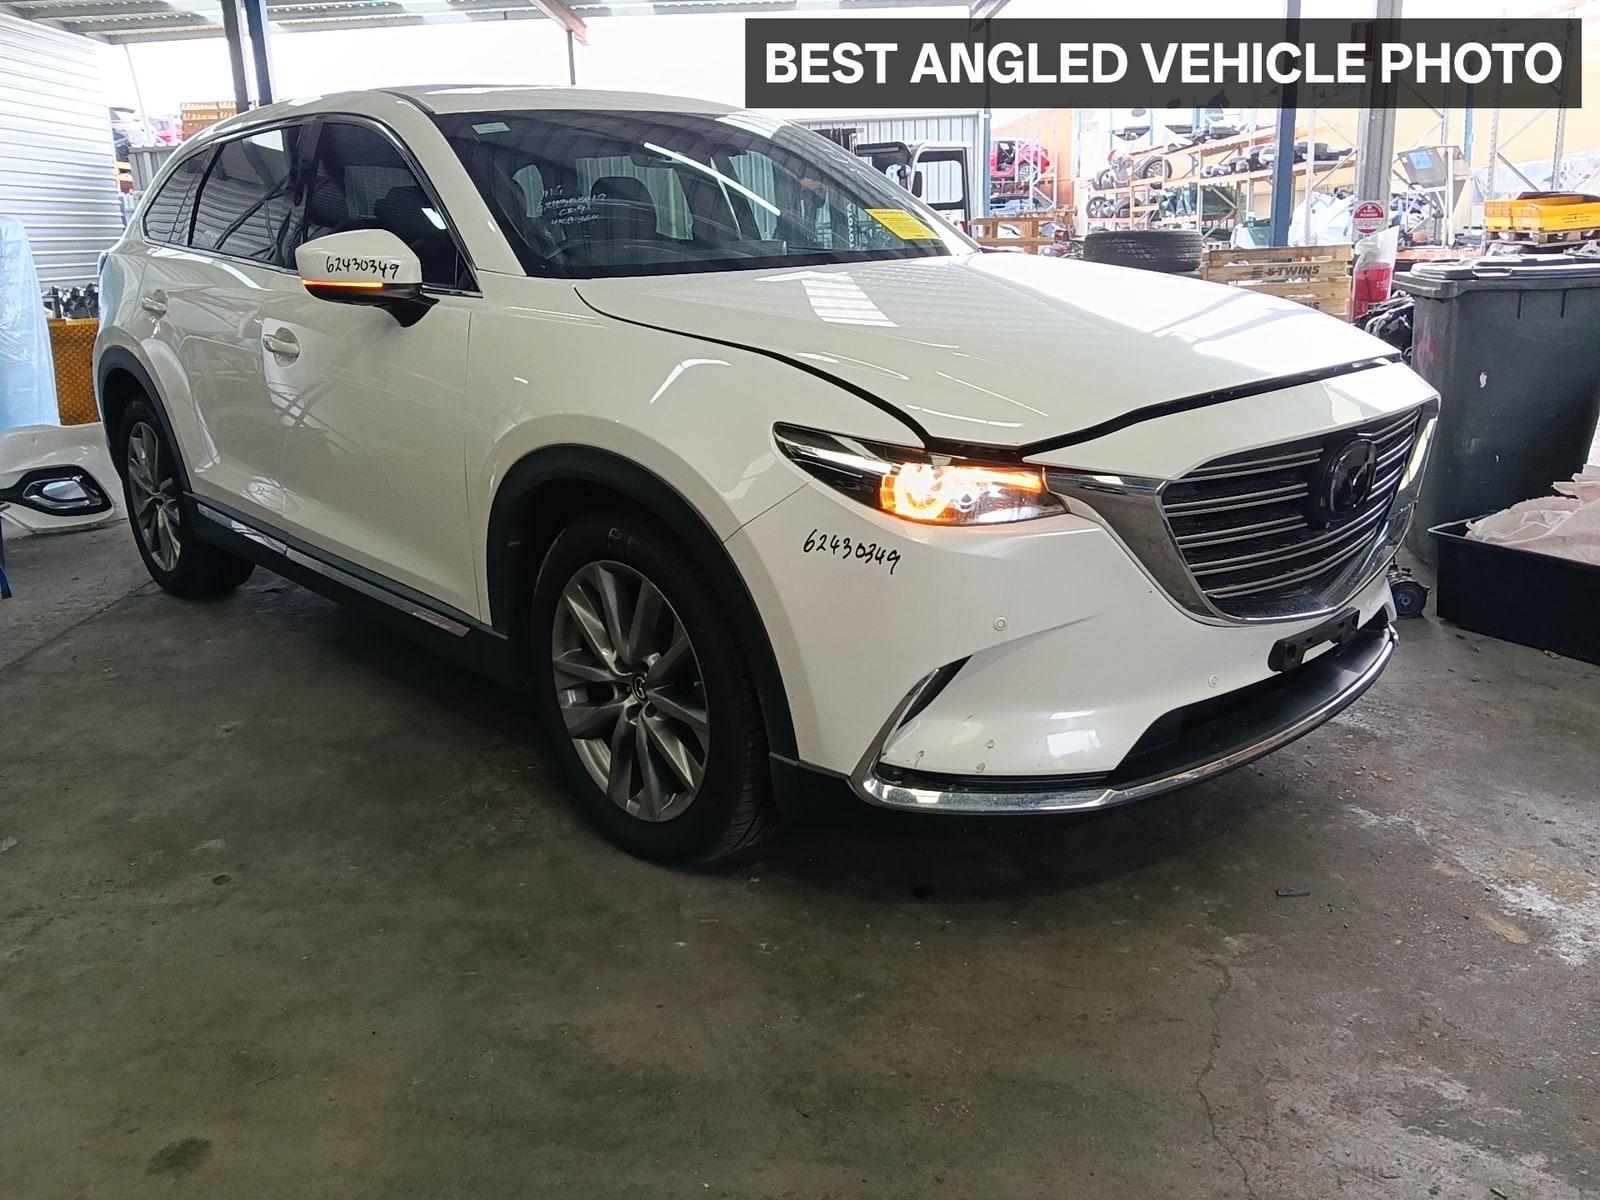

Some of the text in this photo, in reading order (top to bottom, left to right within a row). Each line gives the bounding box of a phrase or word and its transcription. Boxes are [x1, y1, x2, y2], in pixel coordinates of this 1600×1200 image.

[846, 202, 856, 249] TOYOTA
[326, 256, 400, 279] 62430349
[803, 529, 901, 575] 62430349
